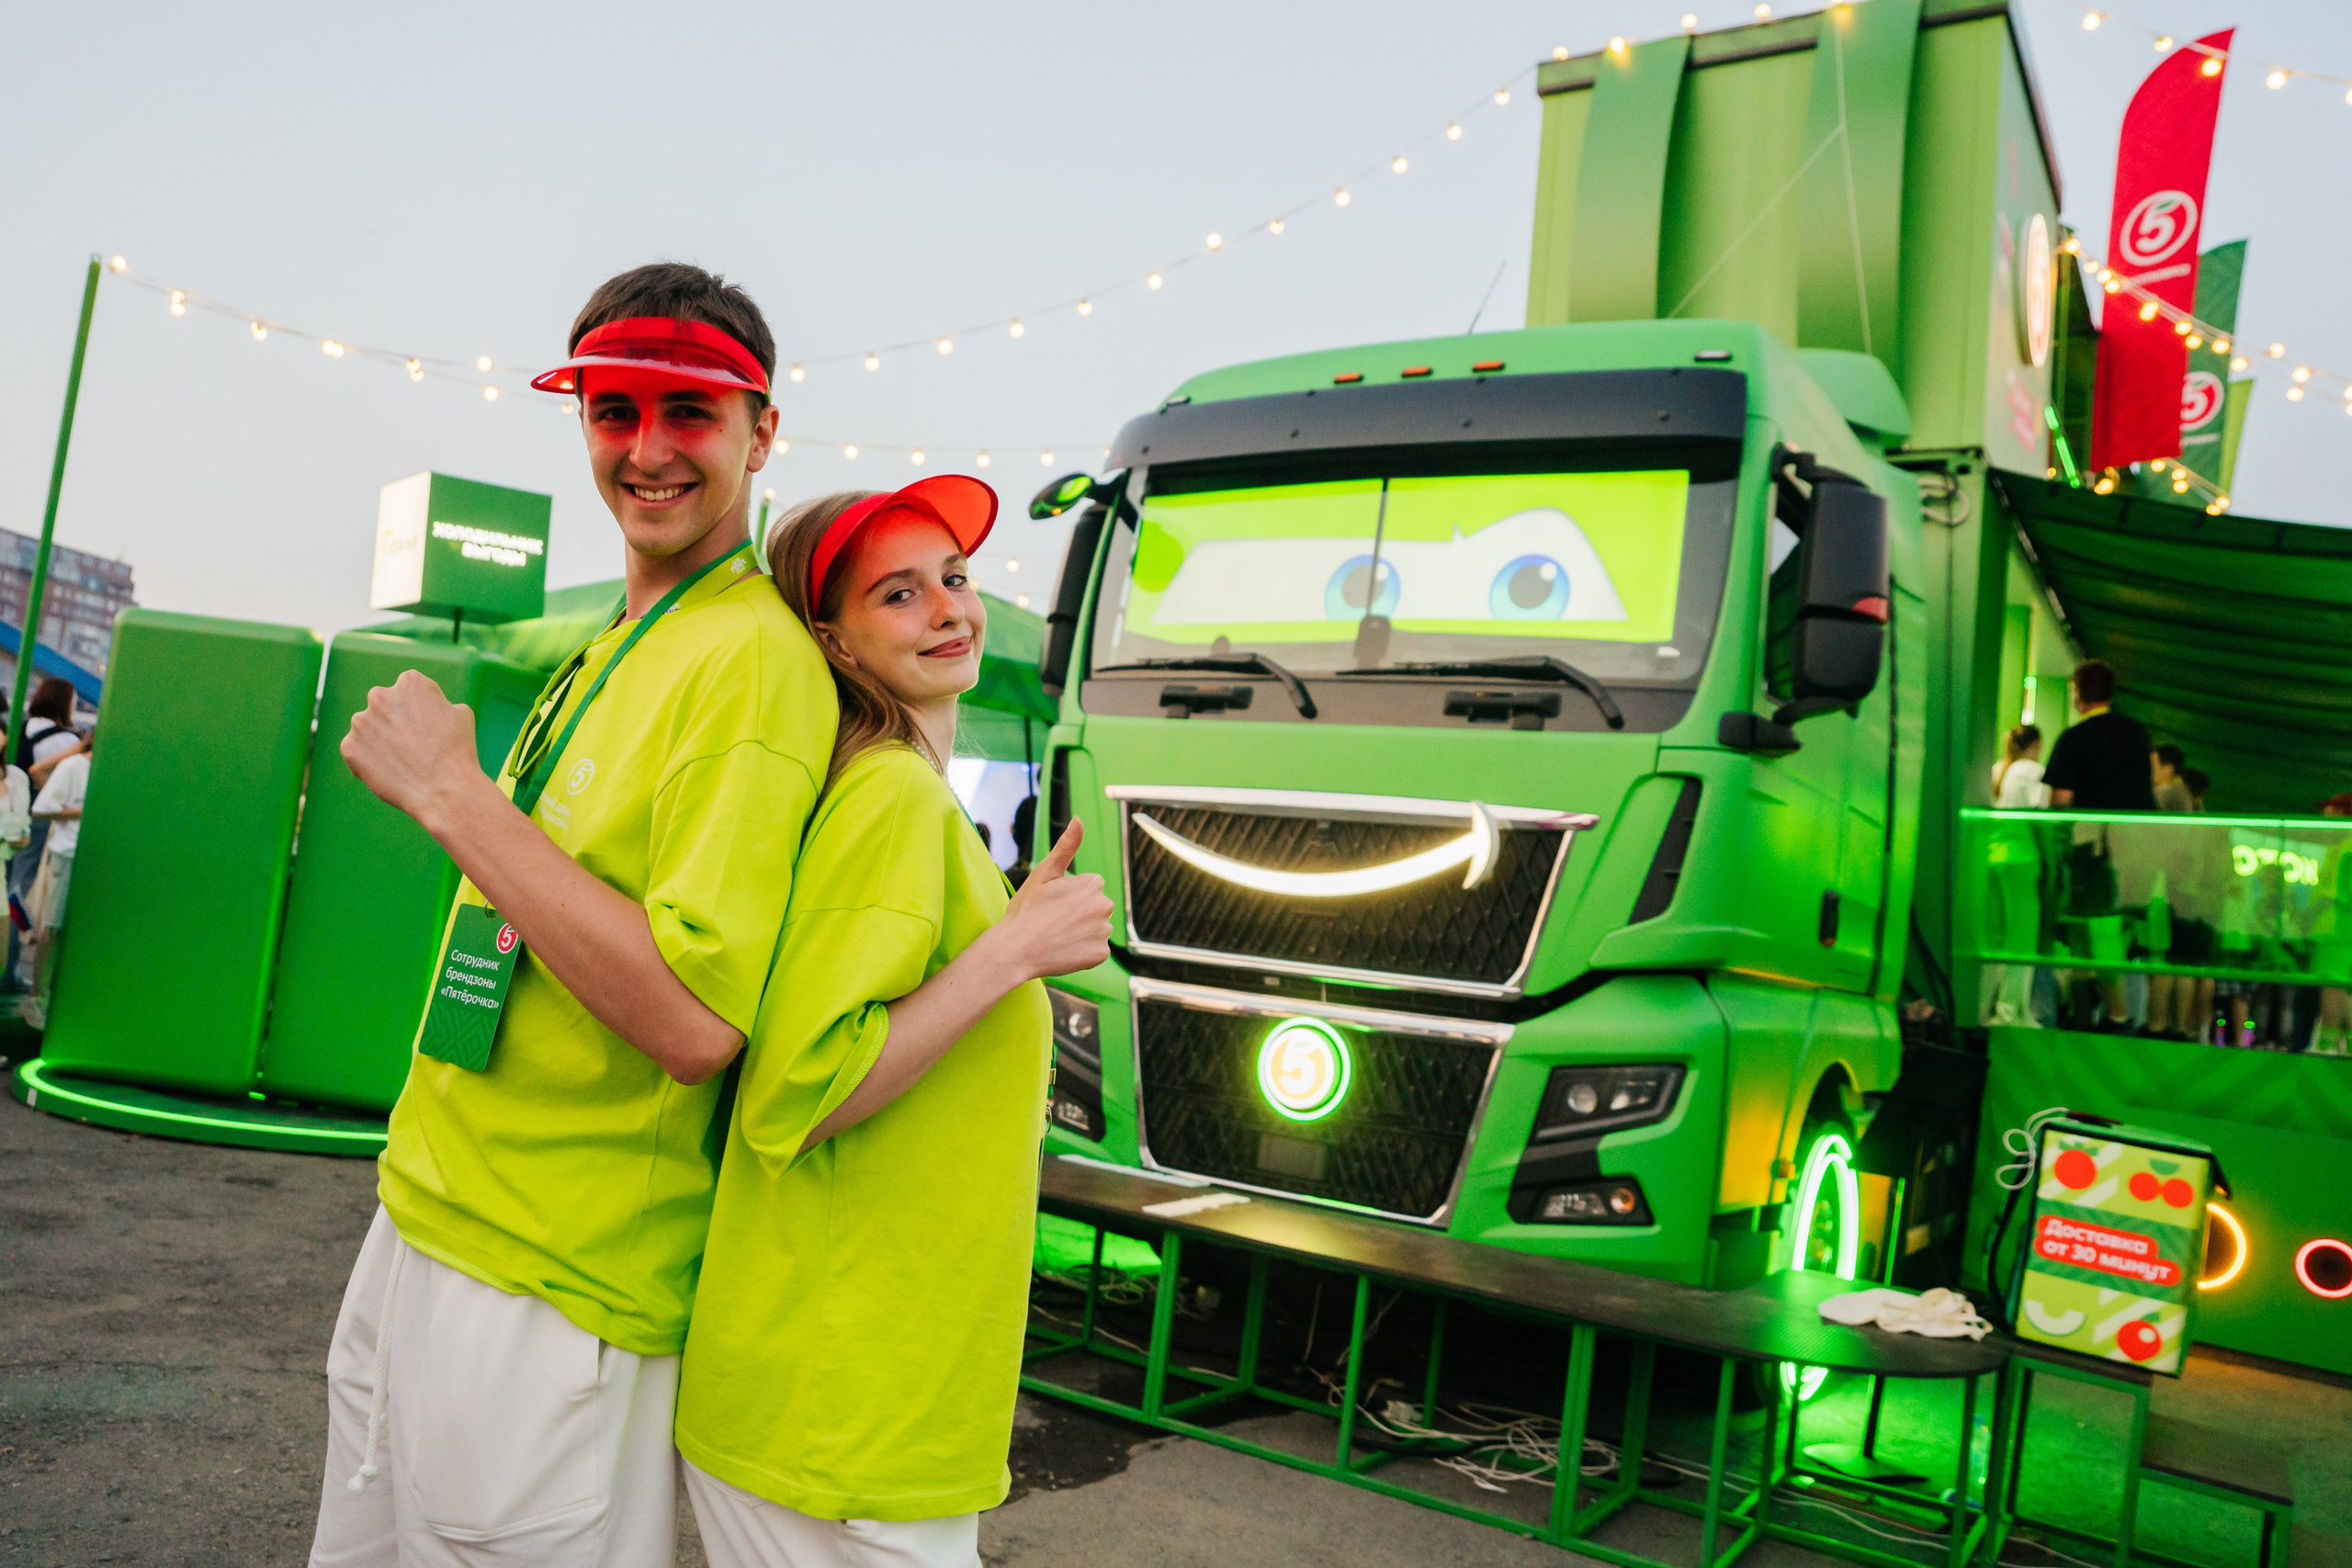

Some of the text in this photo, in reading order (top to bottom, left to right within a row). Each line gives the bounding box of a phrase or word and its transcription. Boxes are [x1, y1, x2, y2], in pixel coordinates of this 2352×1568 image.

[451, 949, 501, 971] Сотрудник
[446, 966, 497, 989] брендзоны
[441, 986, 499, 1009] «Пятёрочка»
[1280, 1038, 1319, 1094] 5
[2043, 1218, 2149, 1255] Доставка
[2042, 1240, 2172, 1281] от 30 минут
